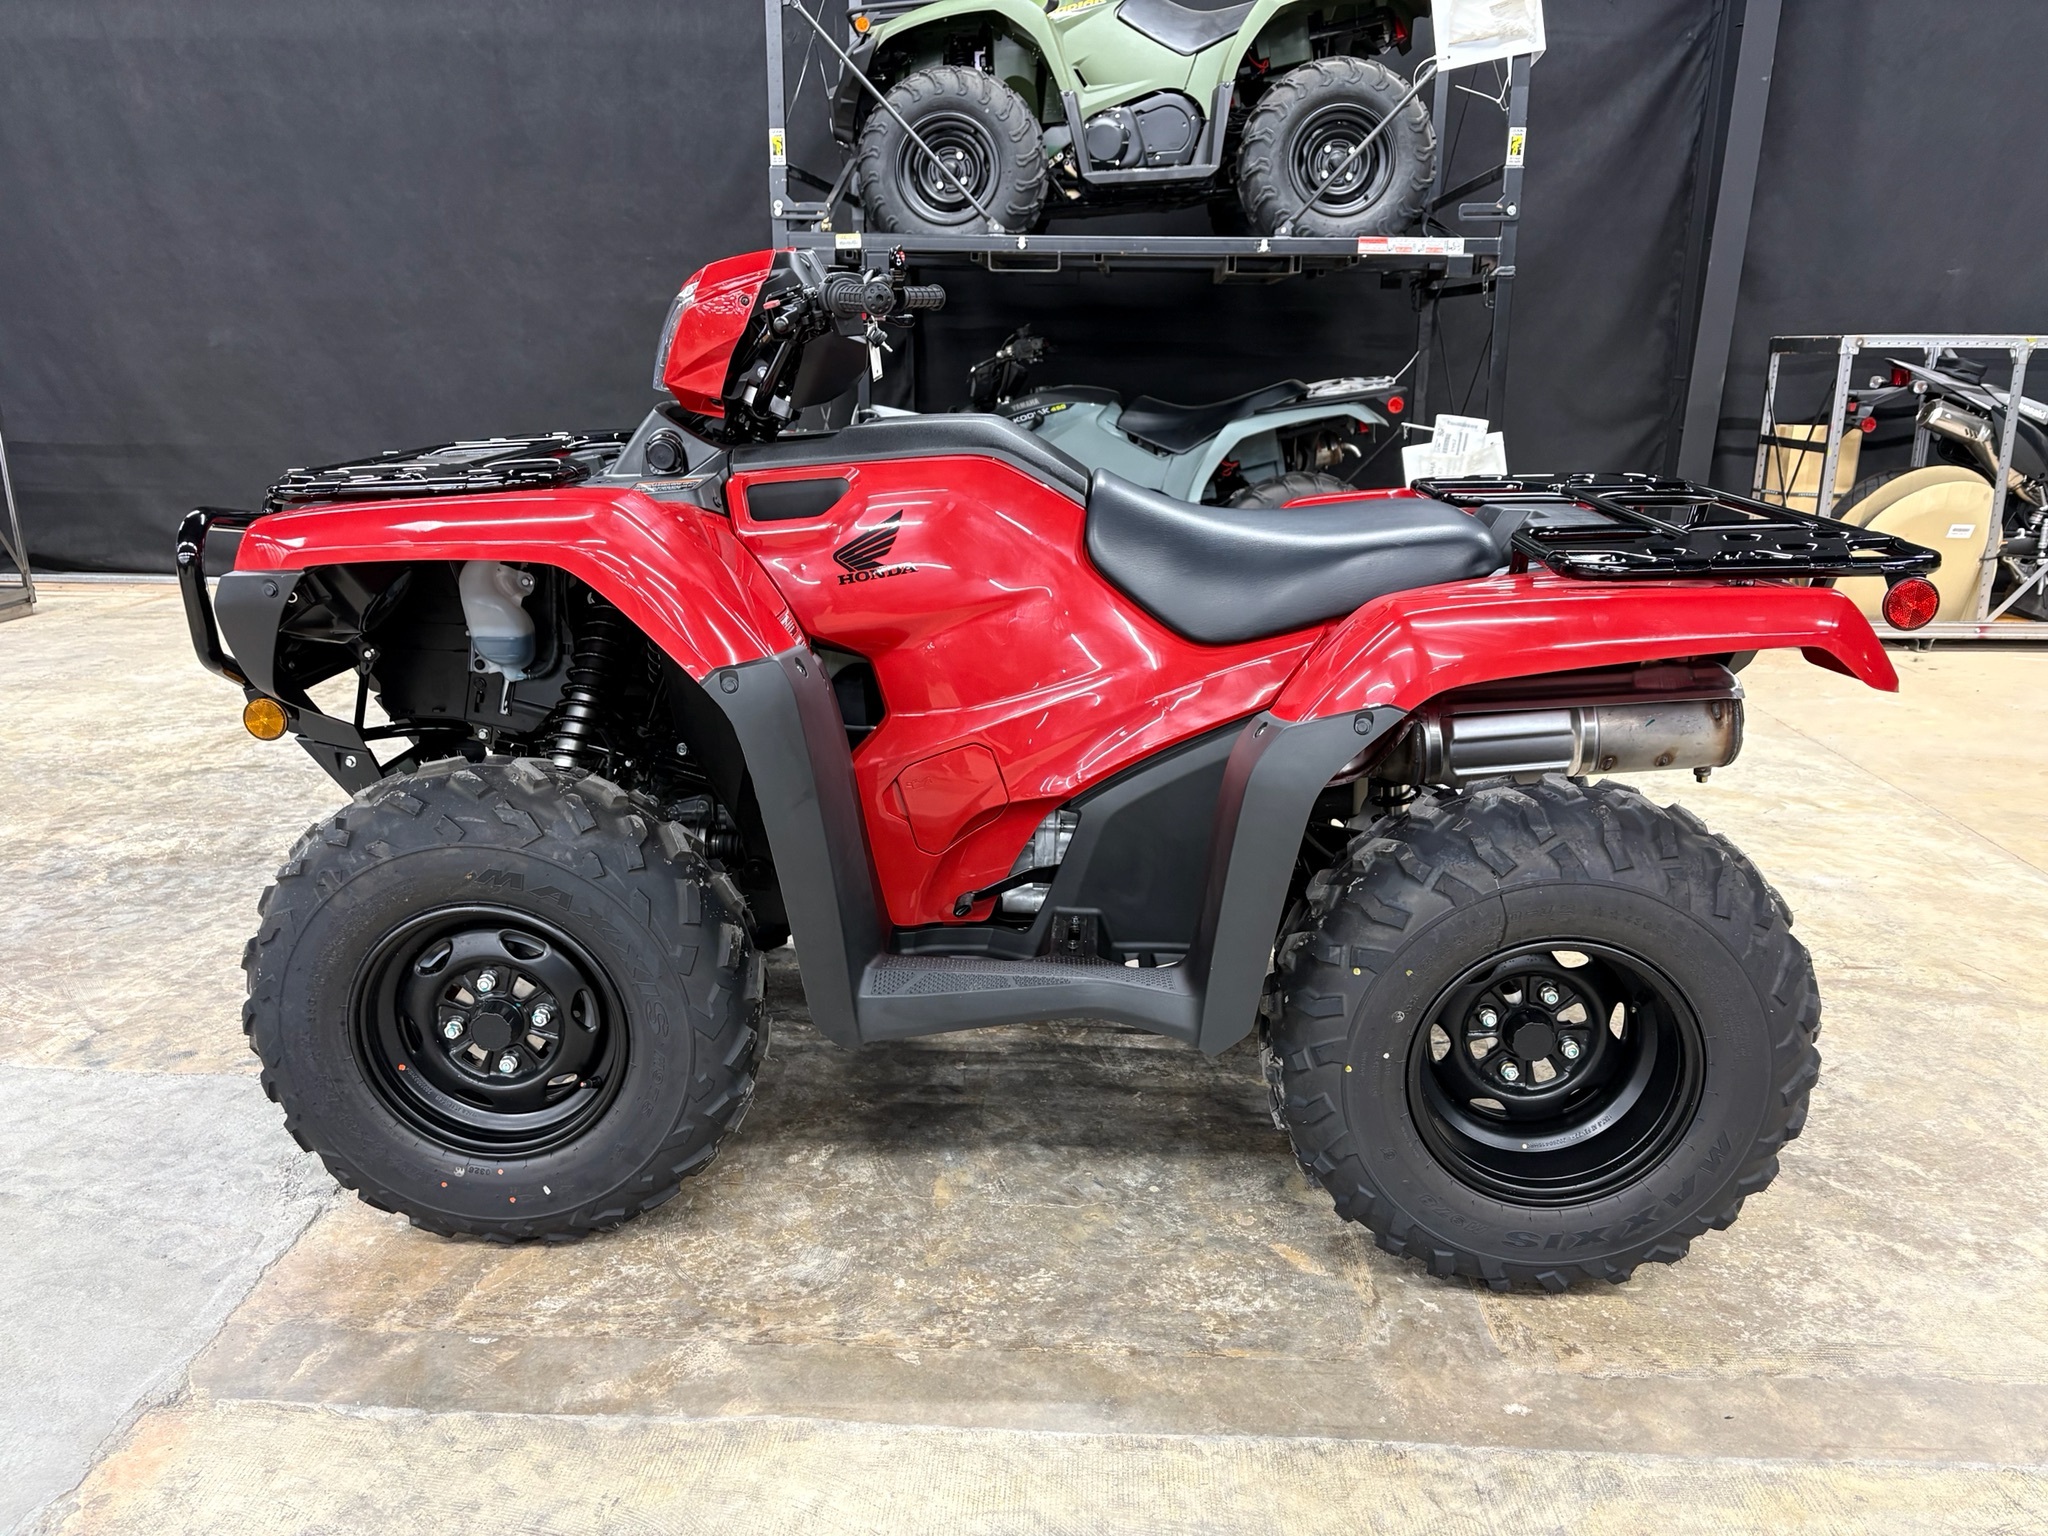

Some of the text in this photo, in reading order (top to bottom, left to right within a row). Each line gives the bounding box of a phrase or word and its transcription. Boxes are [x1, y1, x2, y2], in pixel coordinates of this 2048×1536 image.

[1011, 398, 1040, 411] YAMAHA
[1050, 403, 1067, 412] 450
[837, 563, 919, 585] HONDA
[474, 867, 669, 1039] MAXXIS
[1502, 1131, 1732, 1250] MAXXIS
